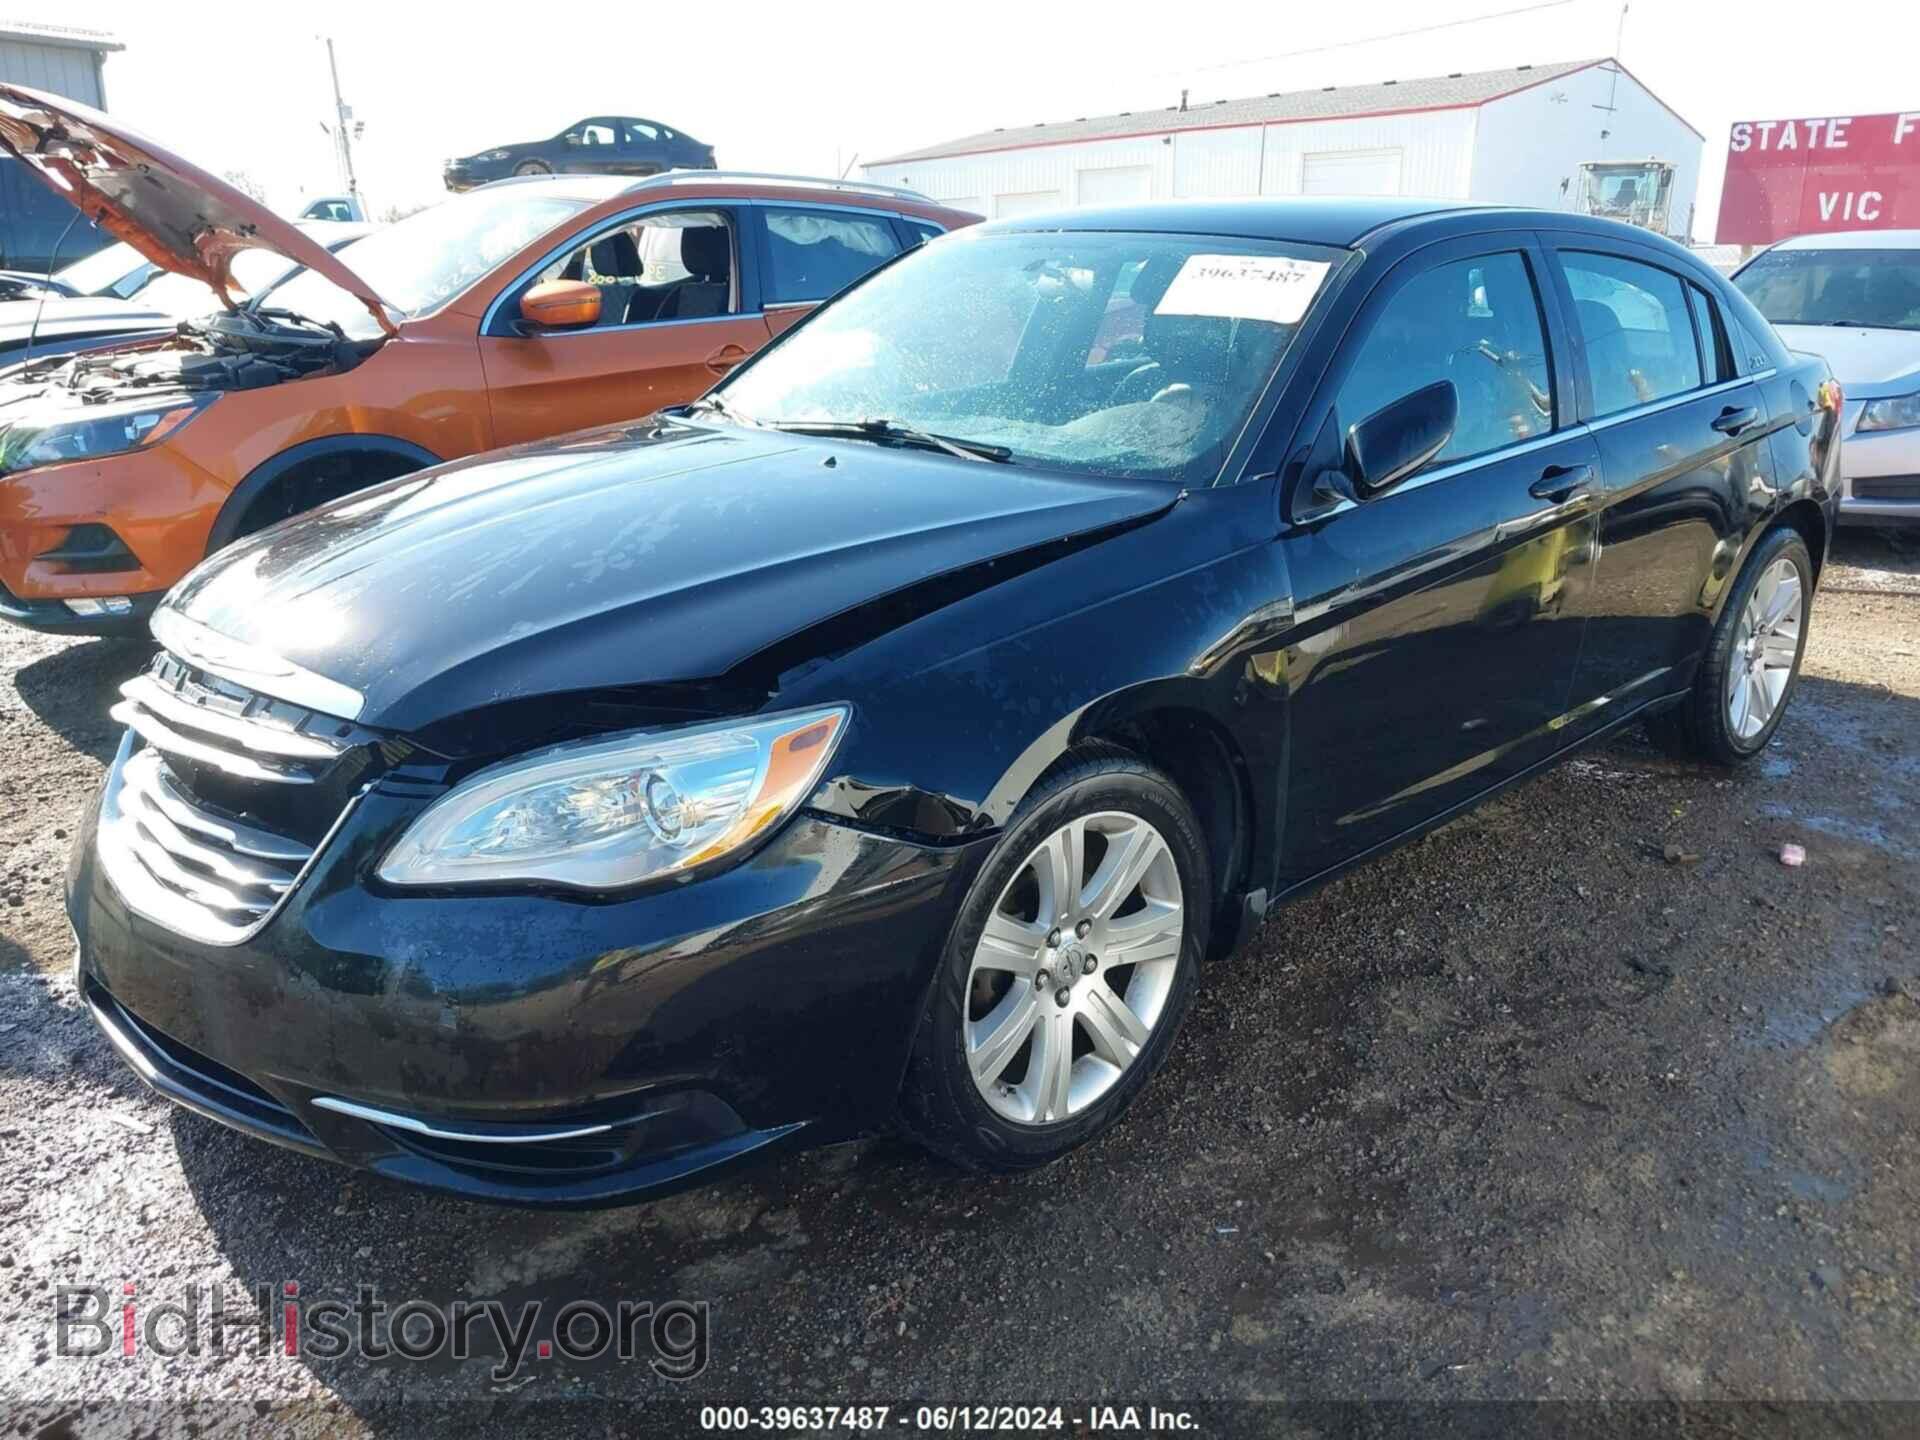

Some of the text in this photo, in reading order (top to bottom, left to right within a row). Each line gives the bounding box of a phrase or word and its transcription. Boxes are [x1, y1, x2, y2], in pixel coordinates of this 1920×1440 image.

[1731, 114, 1920, 152] STATE F
[1818, 191, 1882, 221] VIC
